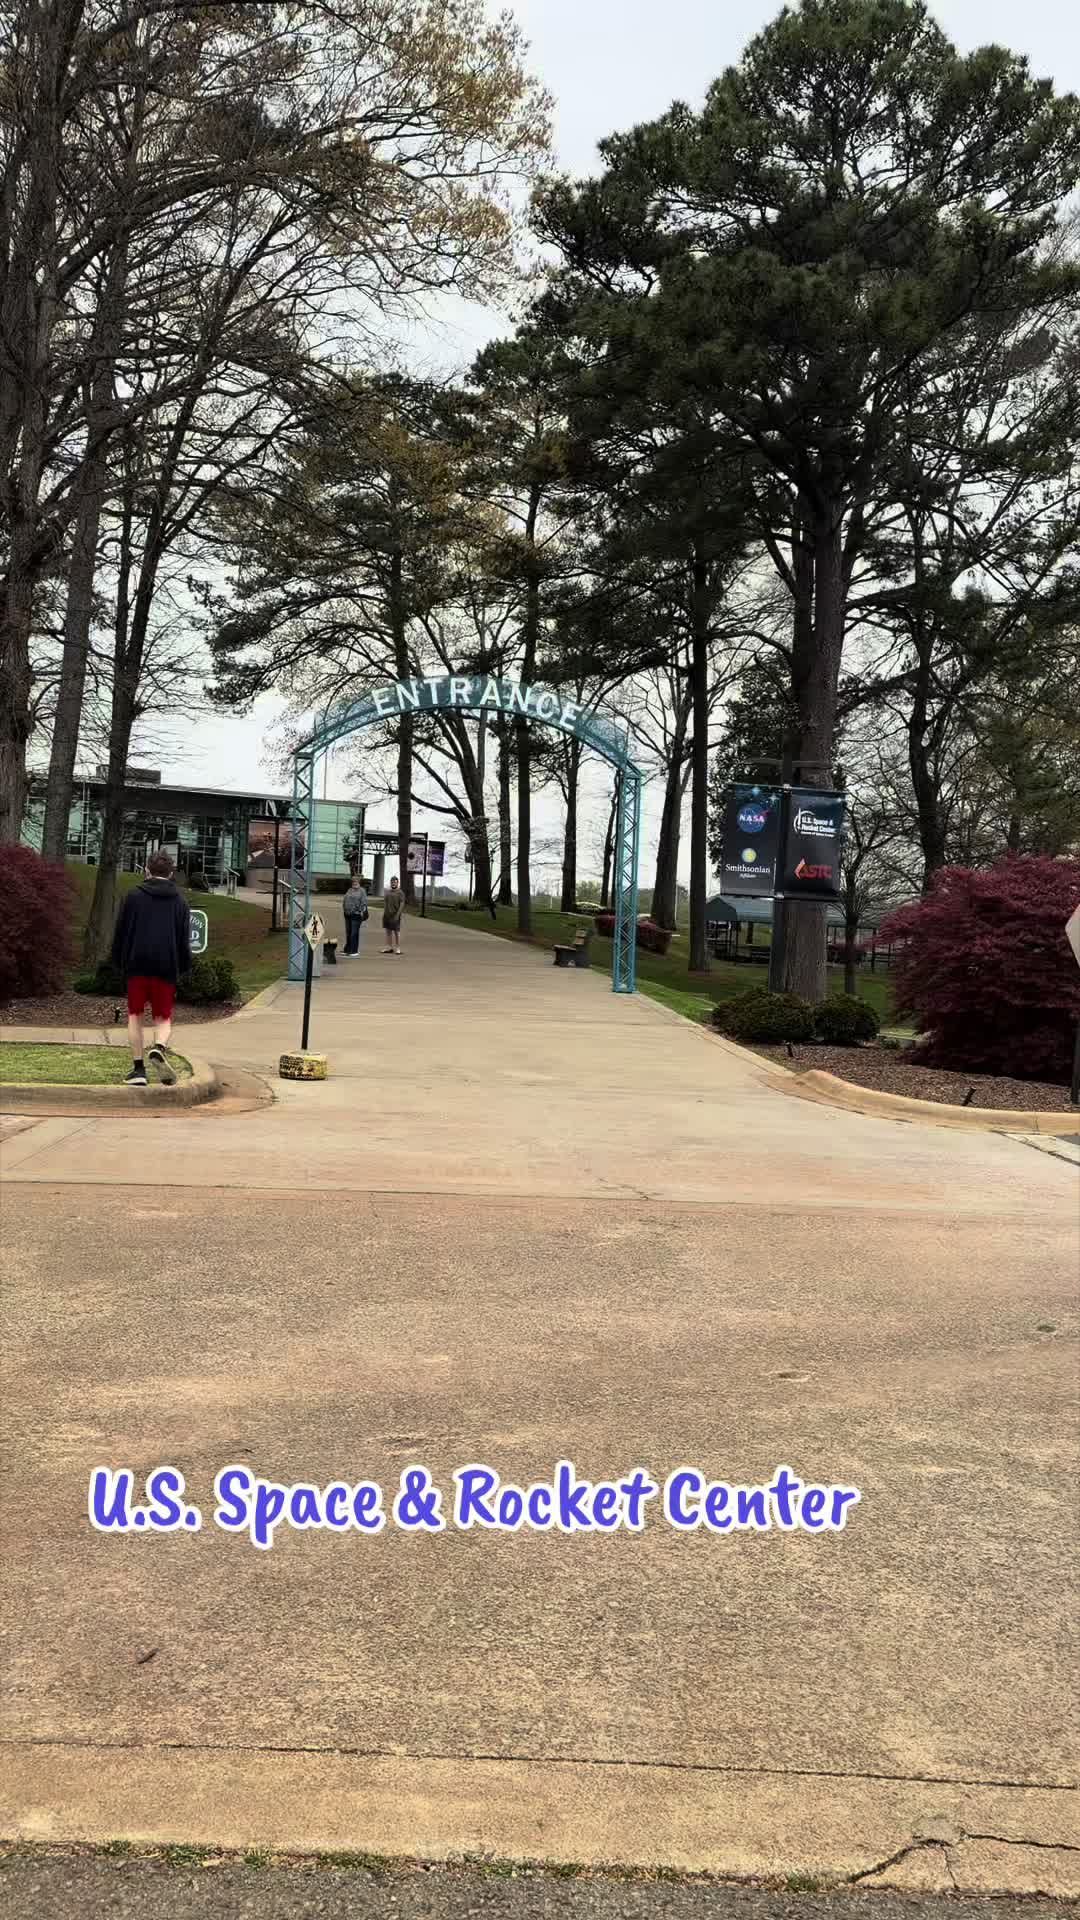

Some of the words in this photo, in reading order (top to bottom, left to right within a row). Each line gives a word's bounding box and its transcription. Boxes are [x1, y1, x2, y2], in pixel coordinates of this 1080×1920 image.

[372, 677, 584, 730] ENTRANCE
[739, 814, 766, 823] NASA
[725, 863, 771, 874] Smithsonian
